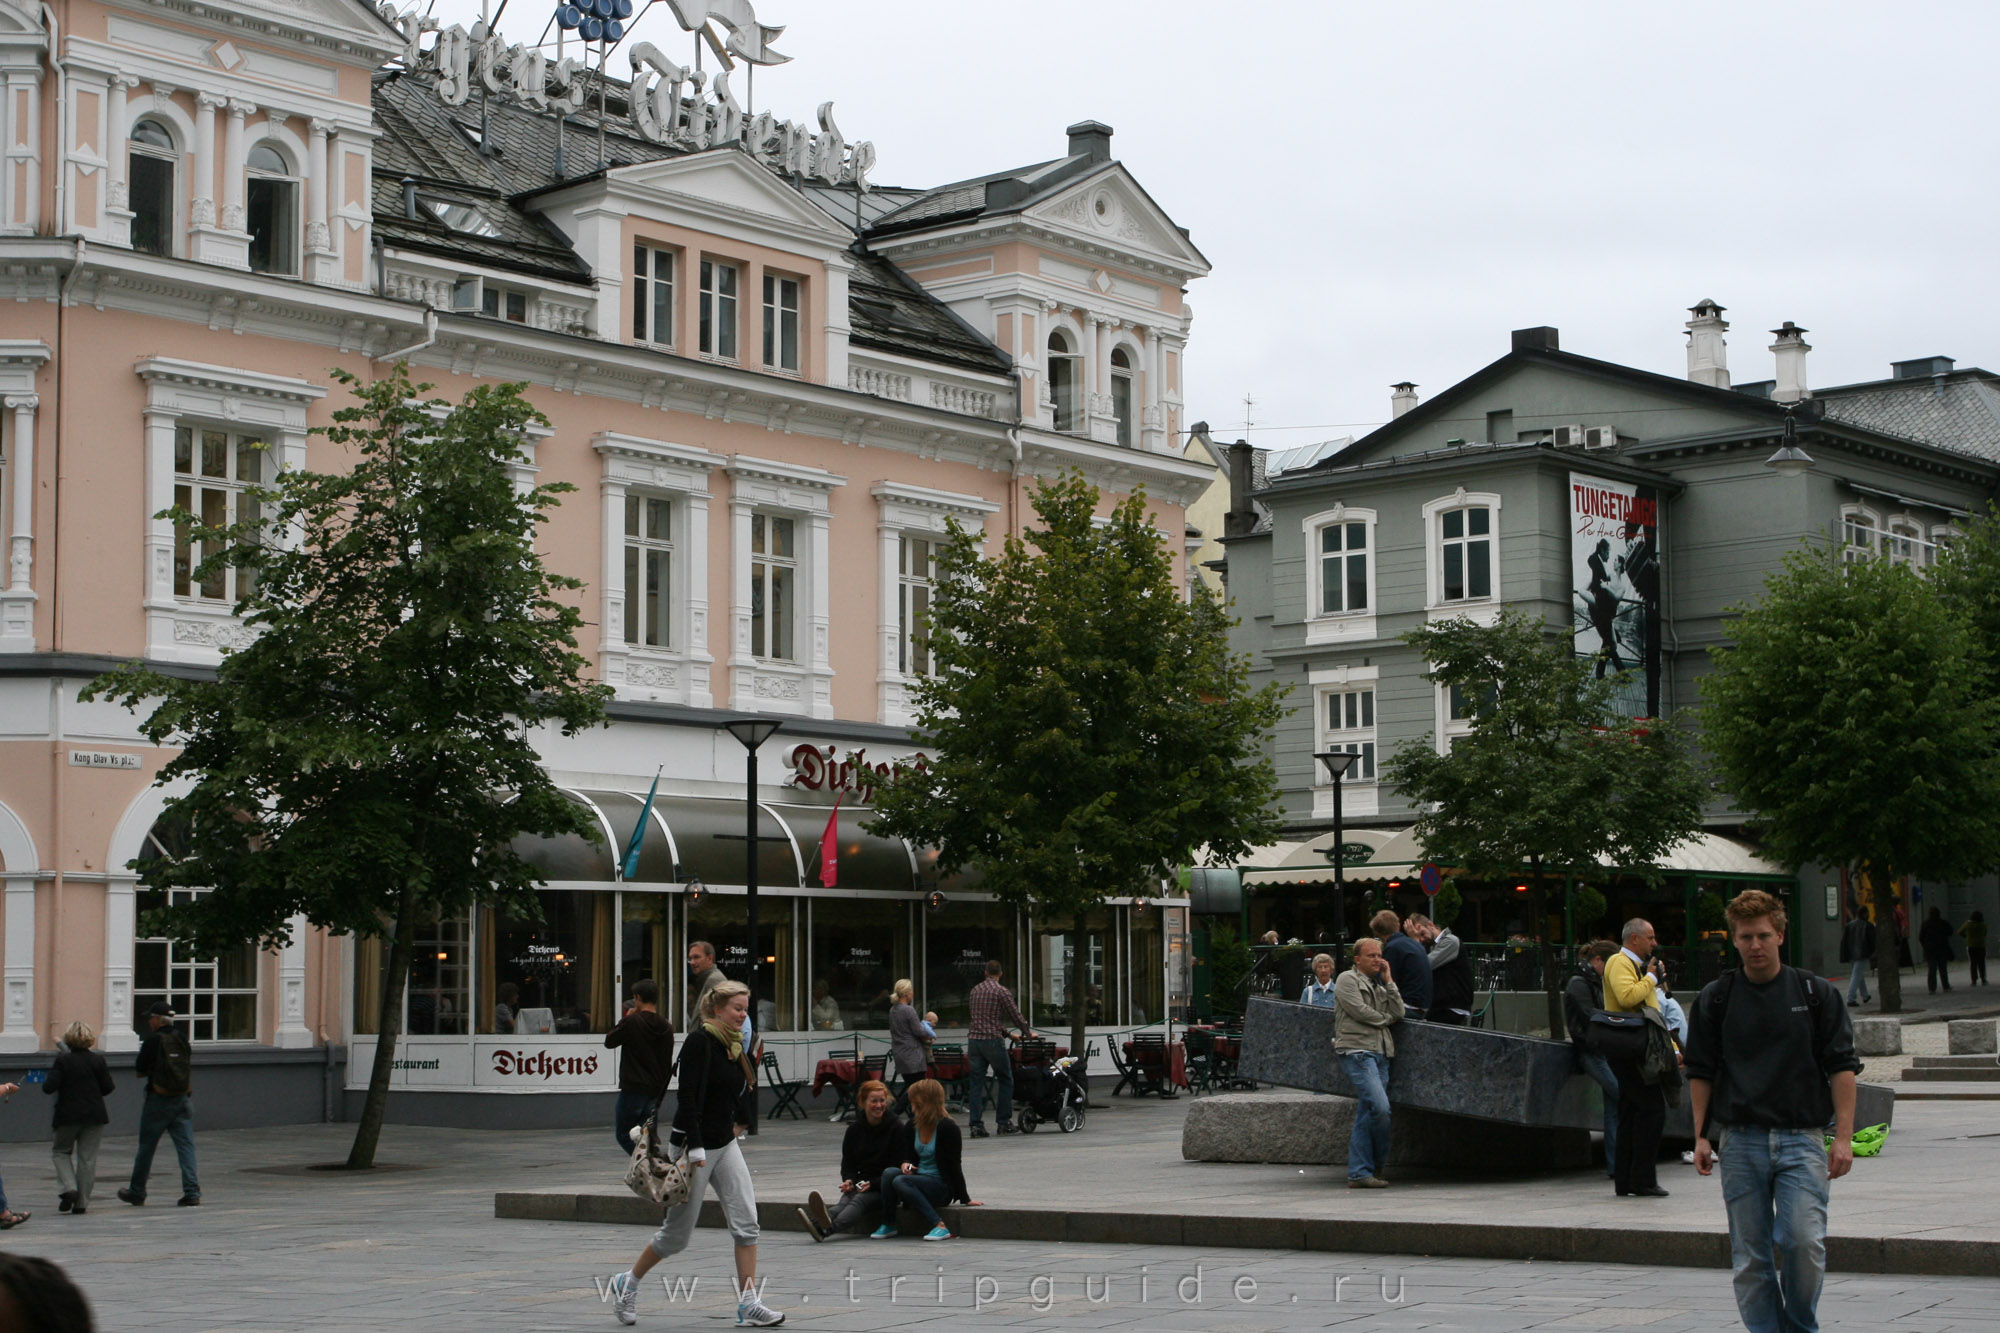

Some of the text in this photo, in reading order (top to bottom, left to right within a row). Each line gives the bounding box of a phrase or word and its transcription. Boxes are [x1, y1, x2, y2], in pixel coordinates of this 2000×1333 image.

[1573, 484, 1657, 528] TUNGETANGO
[74, 752, 91, 764] Kong
[94, 754, 107, 763] Olav
[110, 755, 119, 764] Vs
[528, 946, 560, 954] Dickens
[391, 1058, 439, 1071] estaurant
[491, 1049, 599, 1082] Dickens
